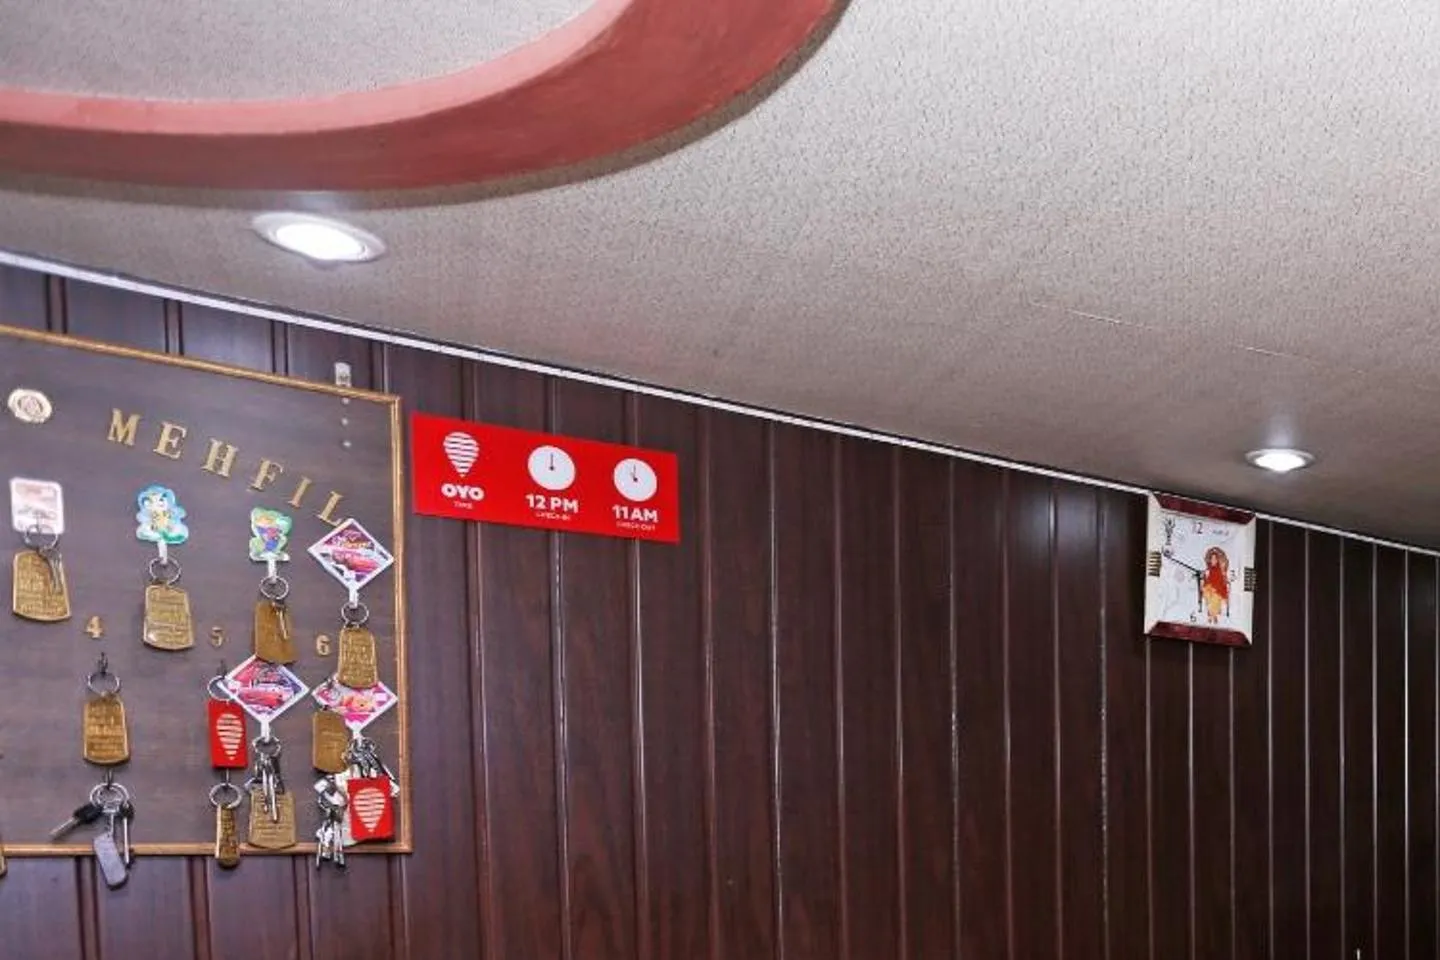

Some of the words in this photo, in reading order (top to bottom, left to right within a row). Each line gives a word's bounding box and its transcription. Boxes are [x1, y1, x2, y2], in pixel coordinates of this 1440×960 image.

[107, 408, 344, 527] MEHFIL
[441, 483, 485, 501] OYO
[526, 494, 546, 510] 12
[550, 497, 579, 514] PM
[84, 615, 105, 639] 4
[209, 625, 225, 648] 5
[315, 634, 331, 656] 6
